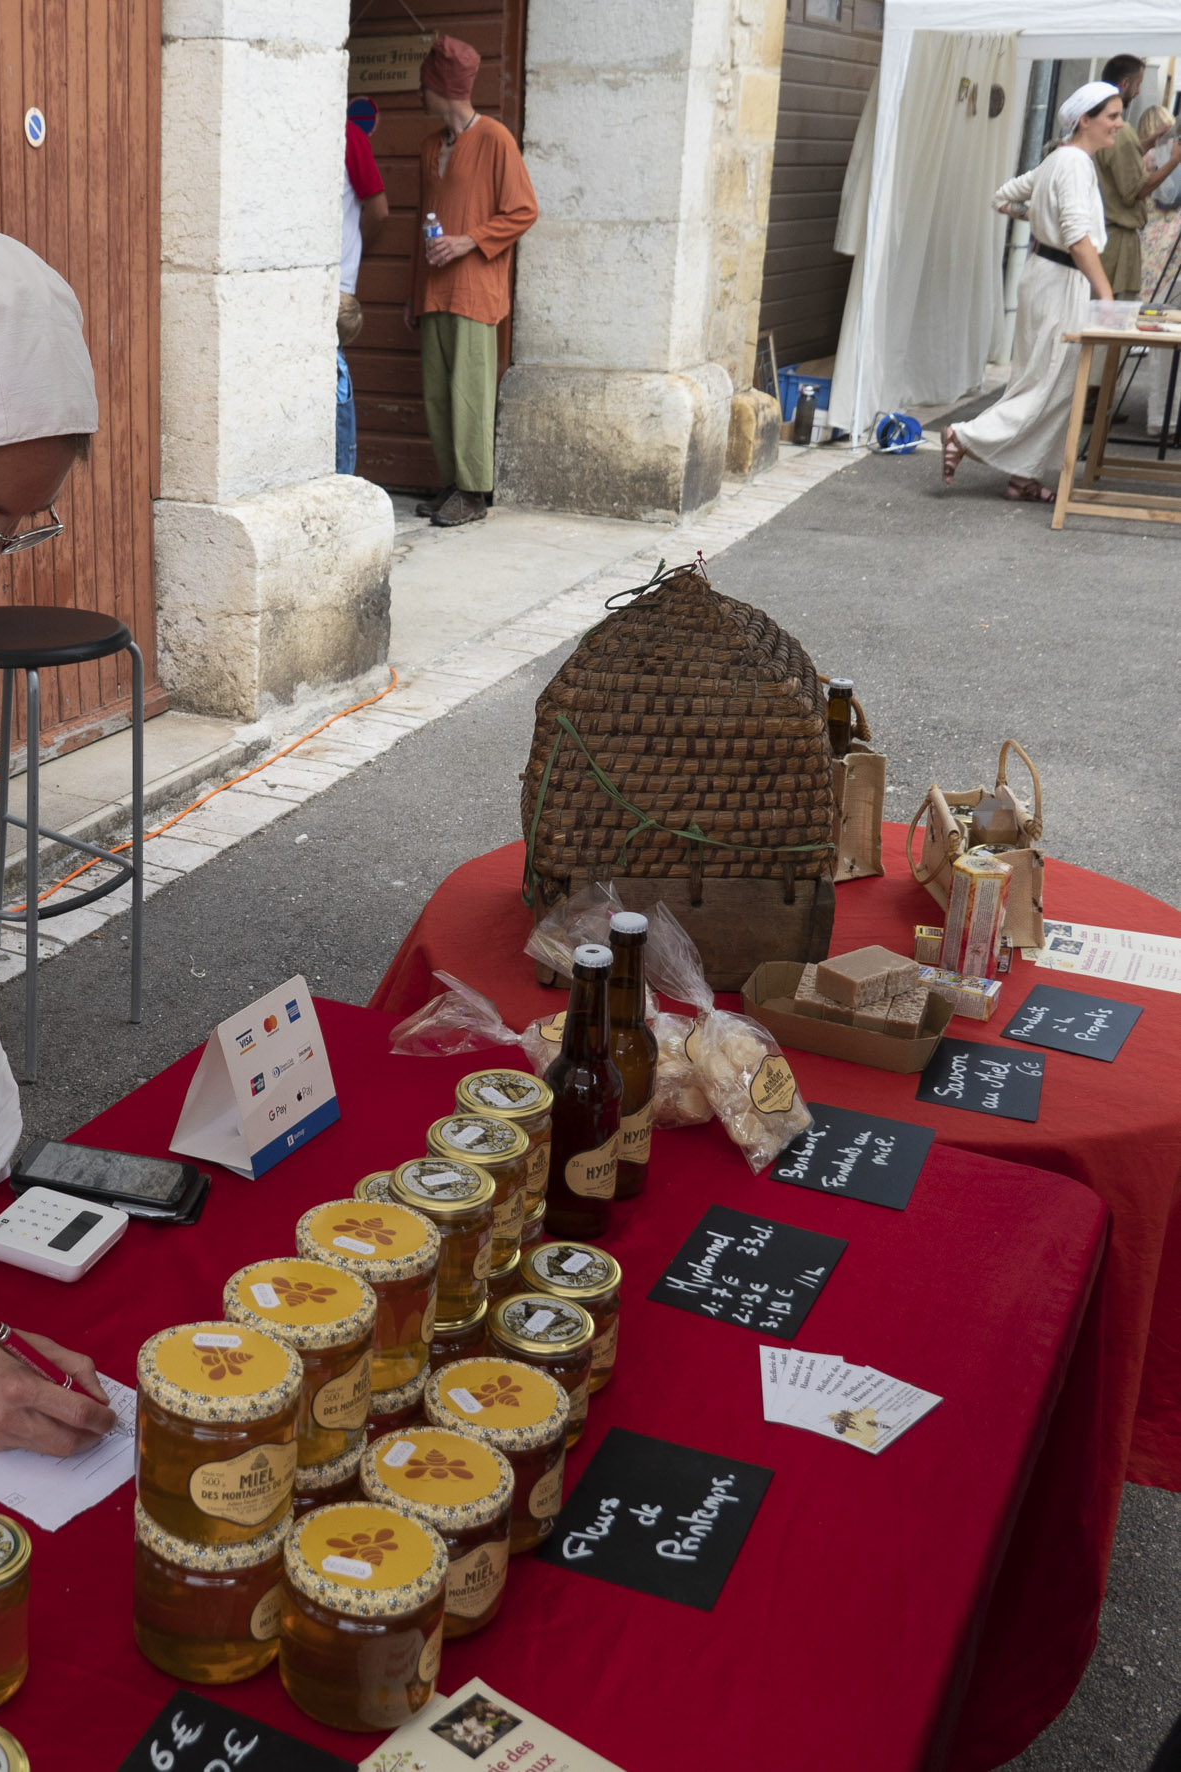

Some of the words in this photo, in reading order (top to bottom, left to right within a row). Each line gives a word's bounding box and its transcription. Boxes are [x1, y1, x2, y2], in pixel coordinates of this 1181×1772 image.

[1074, 1008, 1113, 1041] Propolis
[239, 1035, 253, 1049] VISA
[933, 1053, 969, 1099] Savon
[974, 1060, 1011, 1088] Miel
[1015, 1061, 1043, 1077] 6€
[276, 1104, 288, 1117] Pay
[981, 1092, 1000, 1109] au
[821, 1147, 863, 1187] Fondants
[854, 1131, 872, 1146] au
[841, 1379, 867, 1399] Miellerie
[202, 1476, 221, 1486] 500
[239, 1467, 275, 1490] MIEL
[201, 1490, 219, 1500] DES
[222, 1484, 271, 1500] MONTAGNES
[629, 1503, 662, 1525] de
[562, 1498, 620, 1559] Fleurs
[465, 1562, 494, 1586] MIEL
[505, 1740, 536, 1763] des
